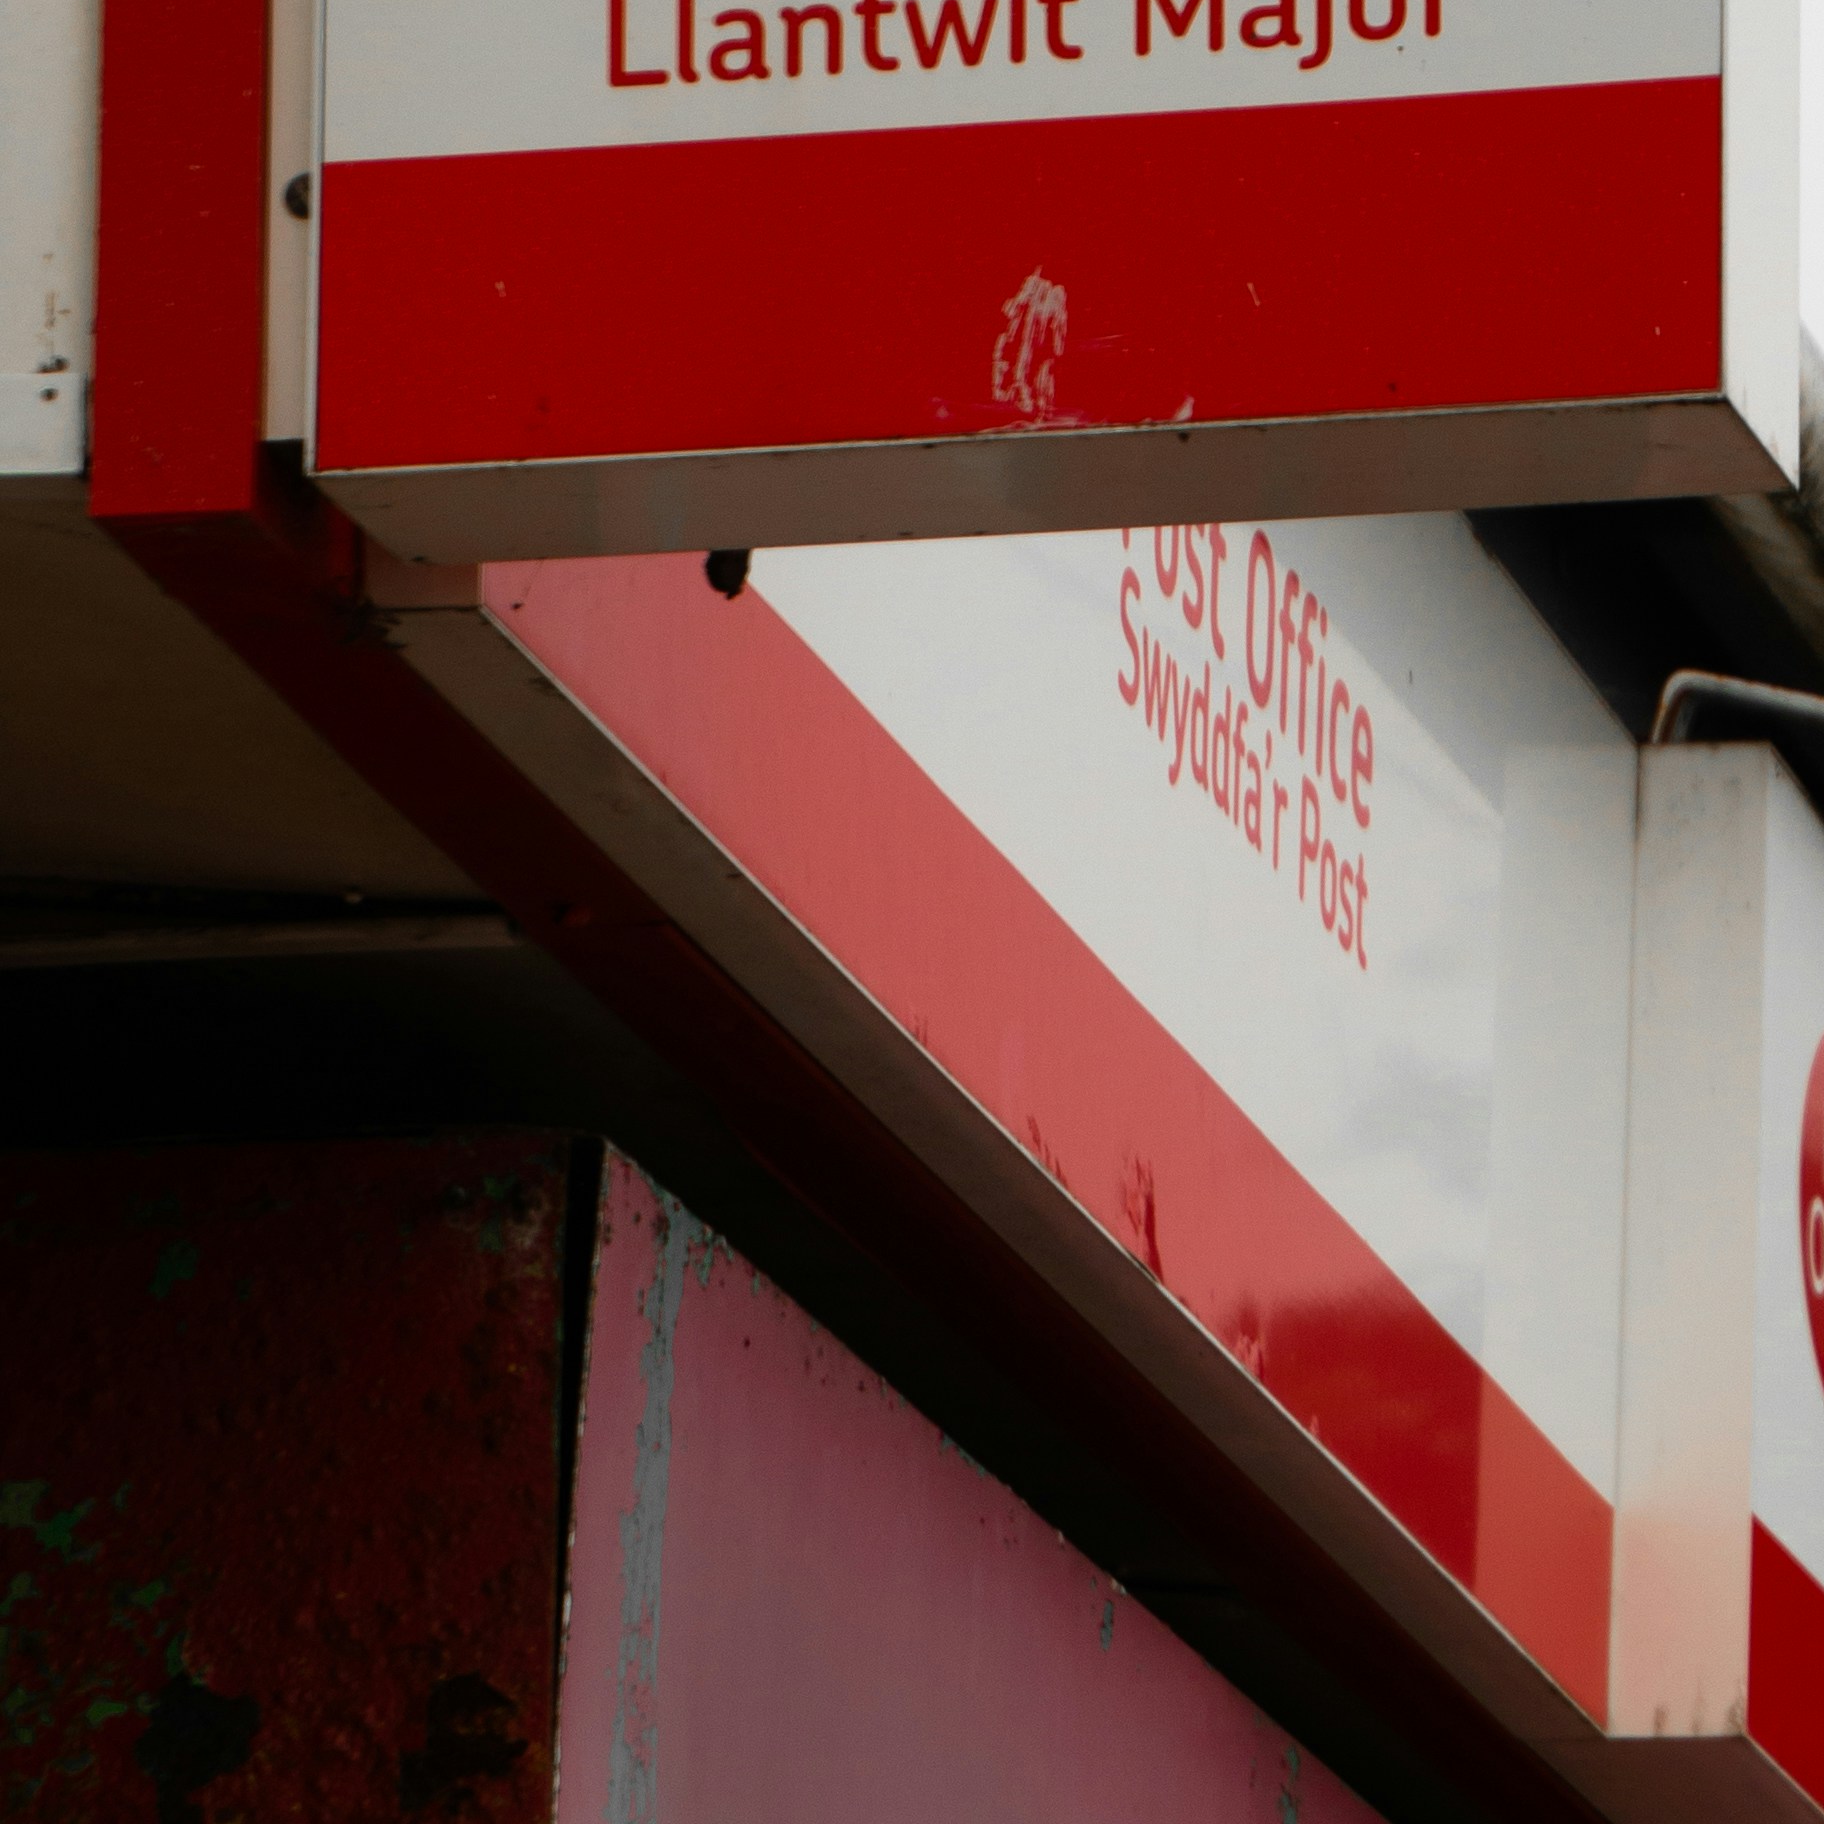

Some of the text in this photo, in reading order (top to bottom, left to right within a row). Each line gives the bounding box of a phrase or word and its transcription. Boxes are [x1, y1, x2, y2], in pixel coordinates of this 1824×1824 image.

[1117, 565, 1369, 972] Swyddfa'r Post
[1121, 522, 1374, 830] ost Office
